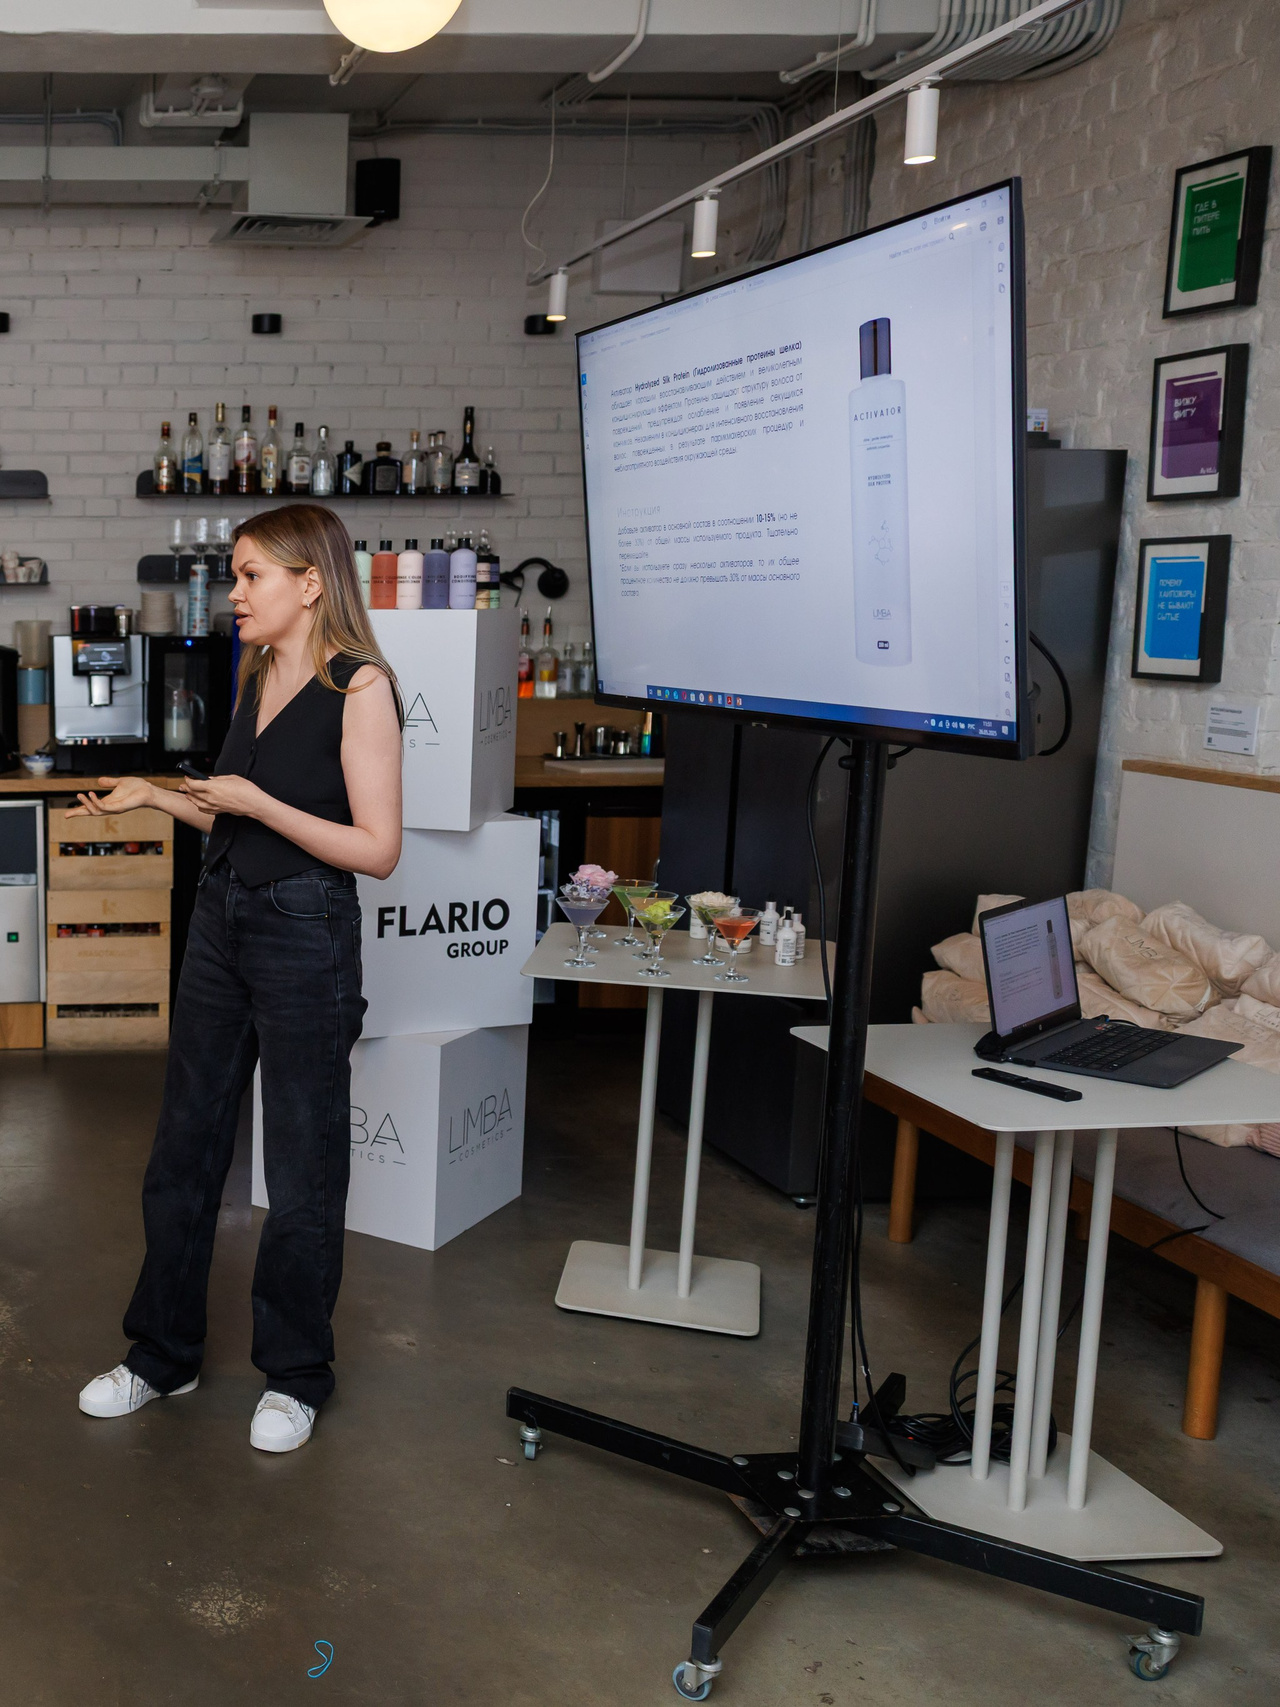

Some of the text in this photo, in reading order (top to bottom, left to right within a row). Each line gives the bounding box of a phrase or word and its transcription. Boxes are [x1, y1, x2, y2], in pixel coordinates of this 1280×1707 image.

[1194, 201, 1209, 212] ГДЕ
[1193, 211, 1220, 224] ПИТЕРЕ
[1192, 226, 1211, 236] ПИТЬ
[634, 378, 660, 392] Hydrolyzed
[662, 375, 670, 385] Silk
[673, 370, 690, 382] Protein
[747, 348, 776, 363] протеины
[716, 372, 746, 385] действием
[758, 357, 802, 375] великолепным
[742, 380, 770, 394] структуру
[771, 376, 794, 388] волоса
[796, 372, 803, 381] от
[734, 396, 764, 410] появление
[1174, 396, 1197, 408] ВИЖУ
[755, 404, 804, 420] восстановления
[854, 406, 901, 421] ACTIVATOR
[1173, 407, 1196, 421] ФИГУ
[762, 421, 793, 434] процедур
[617, 506, 660, 518] Инструкция
[668, 521, 691, 530] основной
[693, 520, 710, 528] состав
[756, 513, 776, 523] 10-15%
[778, 513, 788, 521] (но
[778, 556, 800, 566] общее
[768, 573, 800, 581] основного
[1157, 612, 1180, 620] СЫТЫЕ
[480, 686, 511, 732] LIMBA
[377, 898, 510, 938] FLARIO
[446, 939, 509, 959] GROUP
[449, 1088, 512, 1153] LIMBA
[459, 1132, 504, 1162] COSMETICS
